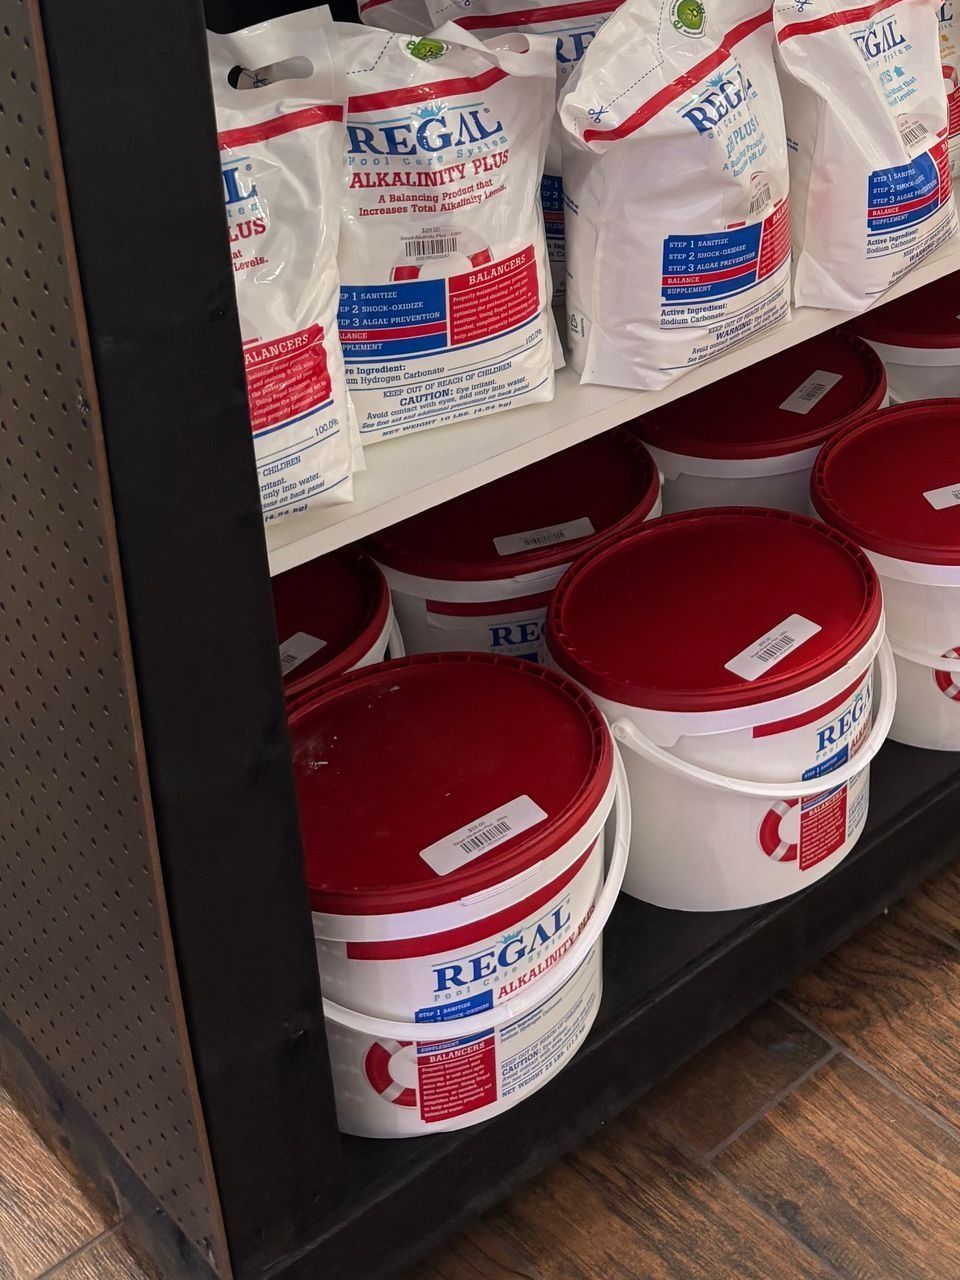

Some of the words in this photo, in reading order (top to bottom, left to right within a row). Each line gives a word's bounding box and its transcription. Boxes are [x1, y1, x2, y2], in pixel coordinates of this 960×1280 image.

[347, 108, 503, 155] REGAL
[348, 157, 390, 166] Pool
[403, 155, 444, 166] Care
[457, 136, 508, 159] System
[350, 163, 465, 189] ALKALINITY
[472, 149, 509, 175] PLUS
[379, 195, 386, 203] A
[389, 194, 439, 204] Balancing
[442, 183, 474, 201] Product
[476, 179, 493, 191] that
[890, 184, 895, 192] 2
[359, 205, 407, 217] Increases
[411, 204, 437, 213] Total
[440, 194, 482, 212] Alkalinity
[872, 206, 900, 216] BALANCE
[872, 214, 908, 225] SUPPLEMENT
[697, 245, 746, 258] SHOCK-OXIDIZE
[698, 238, 729, 247] SANITIZE
[867, 238, 886, 247] Active
[867, 243, 888, 254] Sodium
[889, 236, 917, 250] Carbonate
[234, 257, 268, 271] Levels.
[469, 255, 526, 285] BALANCERS
[697, 261, 719, 270] ALGAE
[720, 252, 756, 267] PREVENTION
[352, 292, 357, 300] 1
[361, 291, 397, 299] SANITIZE
[667, 286, 712, 295] SUPPLEMENT
[352, 305, 359, 314] 2
[362, 302, 423, 313] SHOCK-OXIDIZE
[687, 303, 728, 314] Ingredient:
[690, 311, 724, 323] Carbonate
[352, 318, 359, 326] 3
[362, 317, 389, 325] ALGAE
[391, 311, 440, 324] PREVENTION
[716, 317, 753, 340] WARNING:
[245, 334, 309, 364] ALANCERS
[356, 364, 406, 375] Ingredient:
[361, 372, 400, 385] Hydrogen
[403, 365, 444, 378] Carbonate
[383, 389, 404, 398] KEEP
[406, 385, 423, 395] OUT
[425, 383, 435, 392] OF
[437, 376, 464, 388] REACH
[465, 372, 476, 381] OF
[477, 362, 512, 378] CHILDREN
[367, 411, 389, 420] Avoid
[391, 405, 418, 415] contact
[419, 400, 436, 410] with
[459, 392, 470, 401] add
[472, 388, 489, 399] only
[491, 383, 505, 392] into
[507, 376, 528, 387] water.
[400, 389, 454, 406] CAUTION:
[456, 386, 468, 394] Eye
[470, 378, 497, 390] irritant.
[314, 418, 339, 436] 100.0%
[403, 419, 437, 432] WEIGHT
[263, 456, 301, 477] CHILDREN
[263, 488, 280, 500] only
[282, 482, 297, 493] into
[299, 472, 321, 486] water.
[809, 791, 843, 817] BALANCERS
[433, 904, 571, 993] REGAL
[497, 932, 575, 999] ALKALINITY
[433, 986, 470, 1001] Pool
[483, 966, 518, 987] Care
[429, 1042, 485, 1063] BALANCERS
[502, 1049, 541, 1076] CAUTION:
[518, 1070, 543, 1088] WEIGHT
